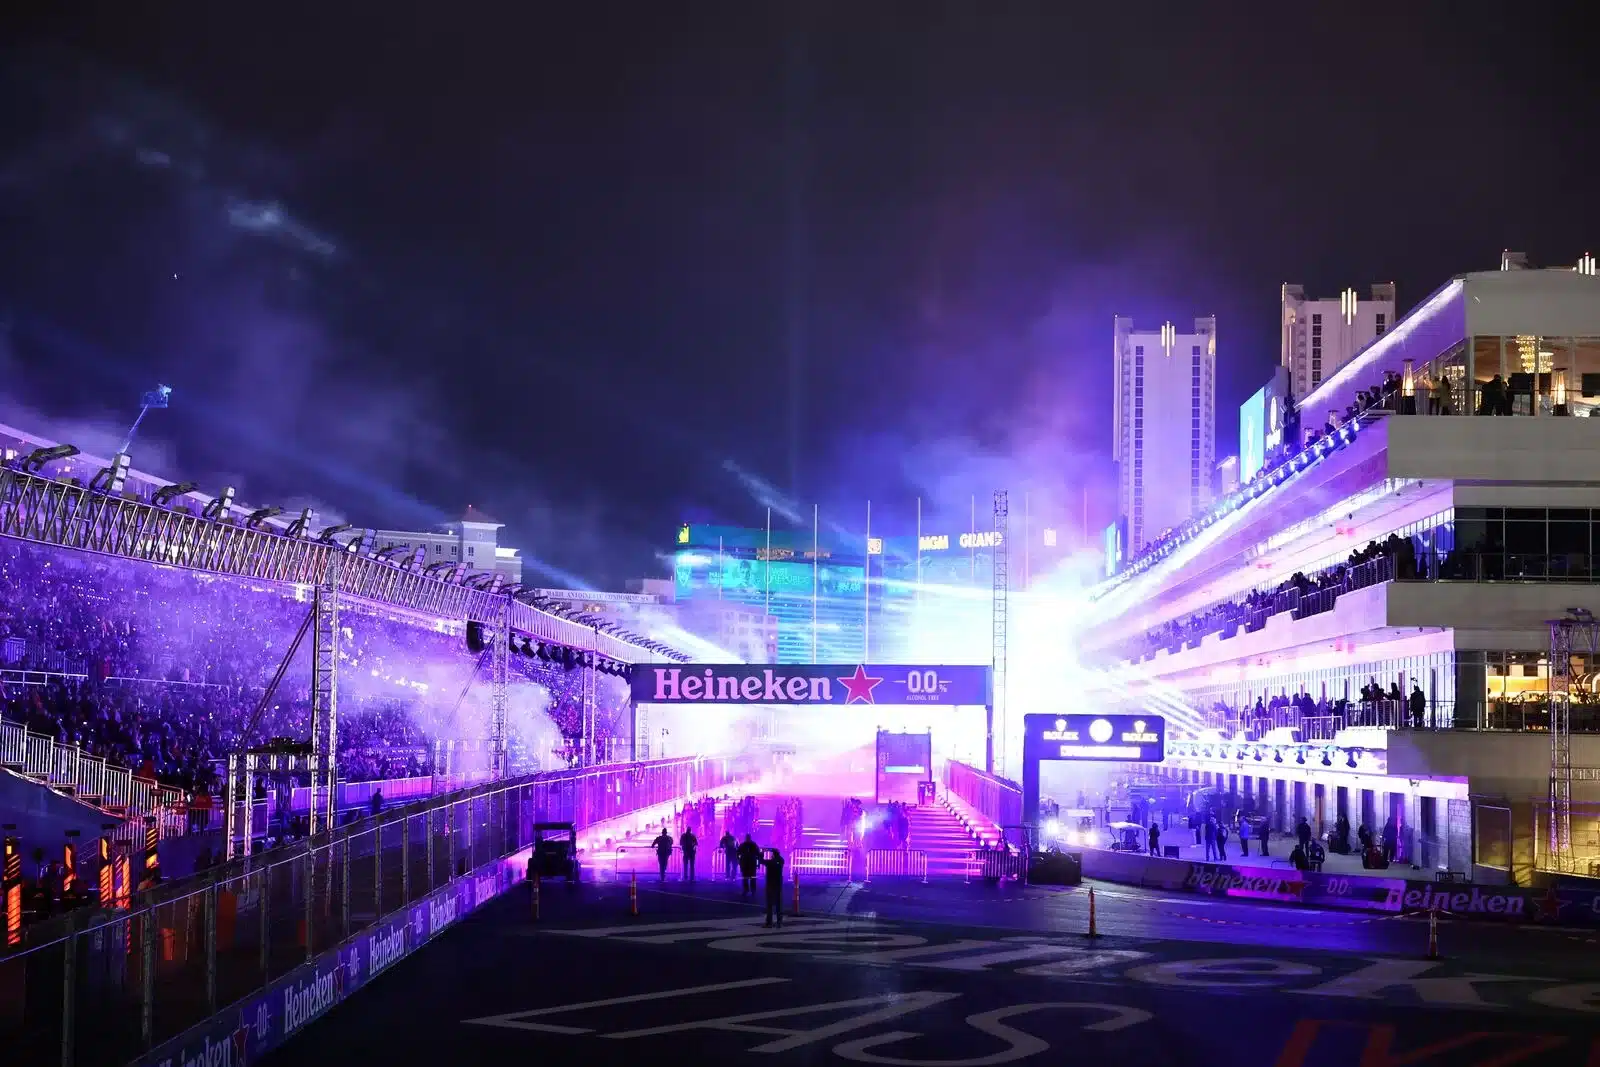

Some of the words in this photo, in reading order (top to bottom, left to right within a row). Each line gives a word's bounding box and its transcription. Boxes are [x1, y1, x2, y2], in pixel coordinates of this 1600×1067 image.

[959, 531, 1004, 548] GRAND
[653, 668, 833, 700] Heineken
[1188, 863, 1284, 894] Heineken
[1384, 881, 1525, 914] Heineken
[369, 924, 405, 977] Heineken
[284, 970, 334, 1035] Heineken
[459, 976, 1153, 1067] LAS
